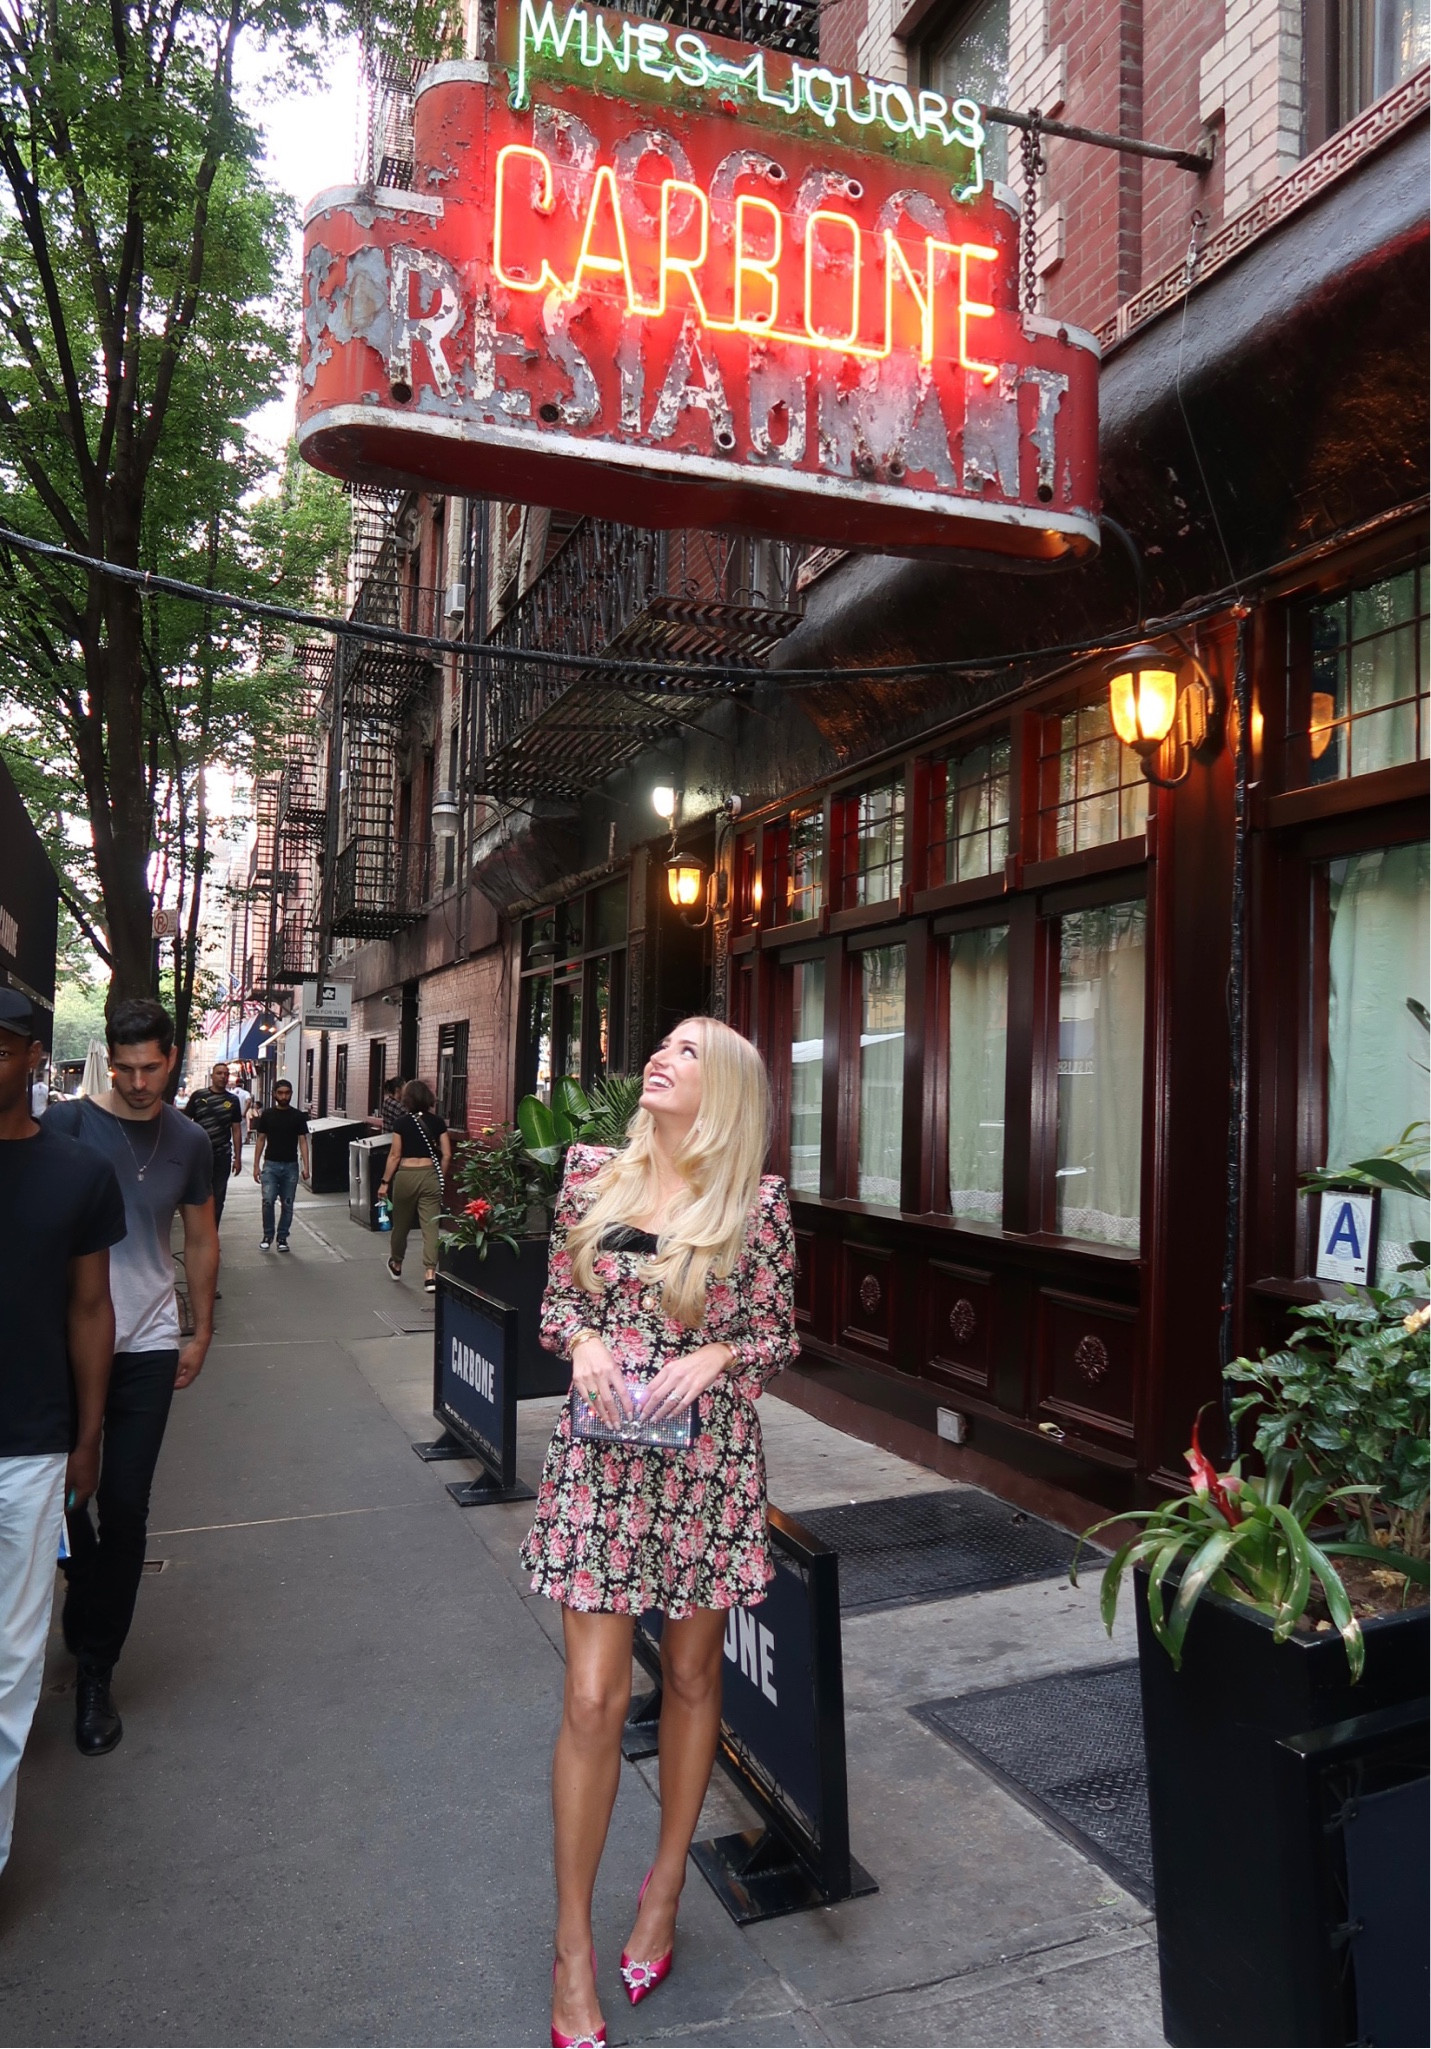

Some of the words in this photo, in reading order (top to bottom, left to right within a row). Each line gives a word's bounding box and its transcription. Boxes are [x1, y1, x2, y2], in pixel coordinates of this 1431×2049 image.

[493, 144, 1000, 380] CARBONE
[1325, 1202, 1361, 1259] A
[451, 1336, 494, 1404] CARBONE
